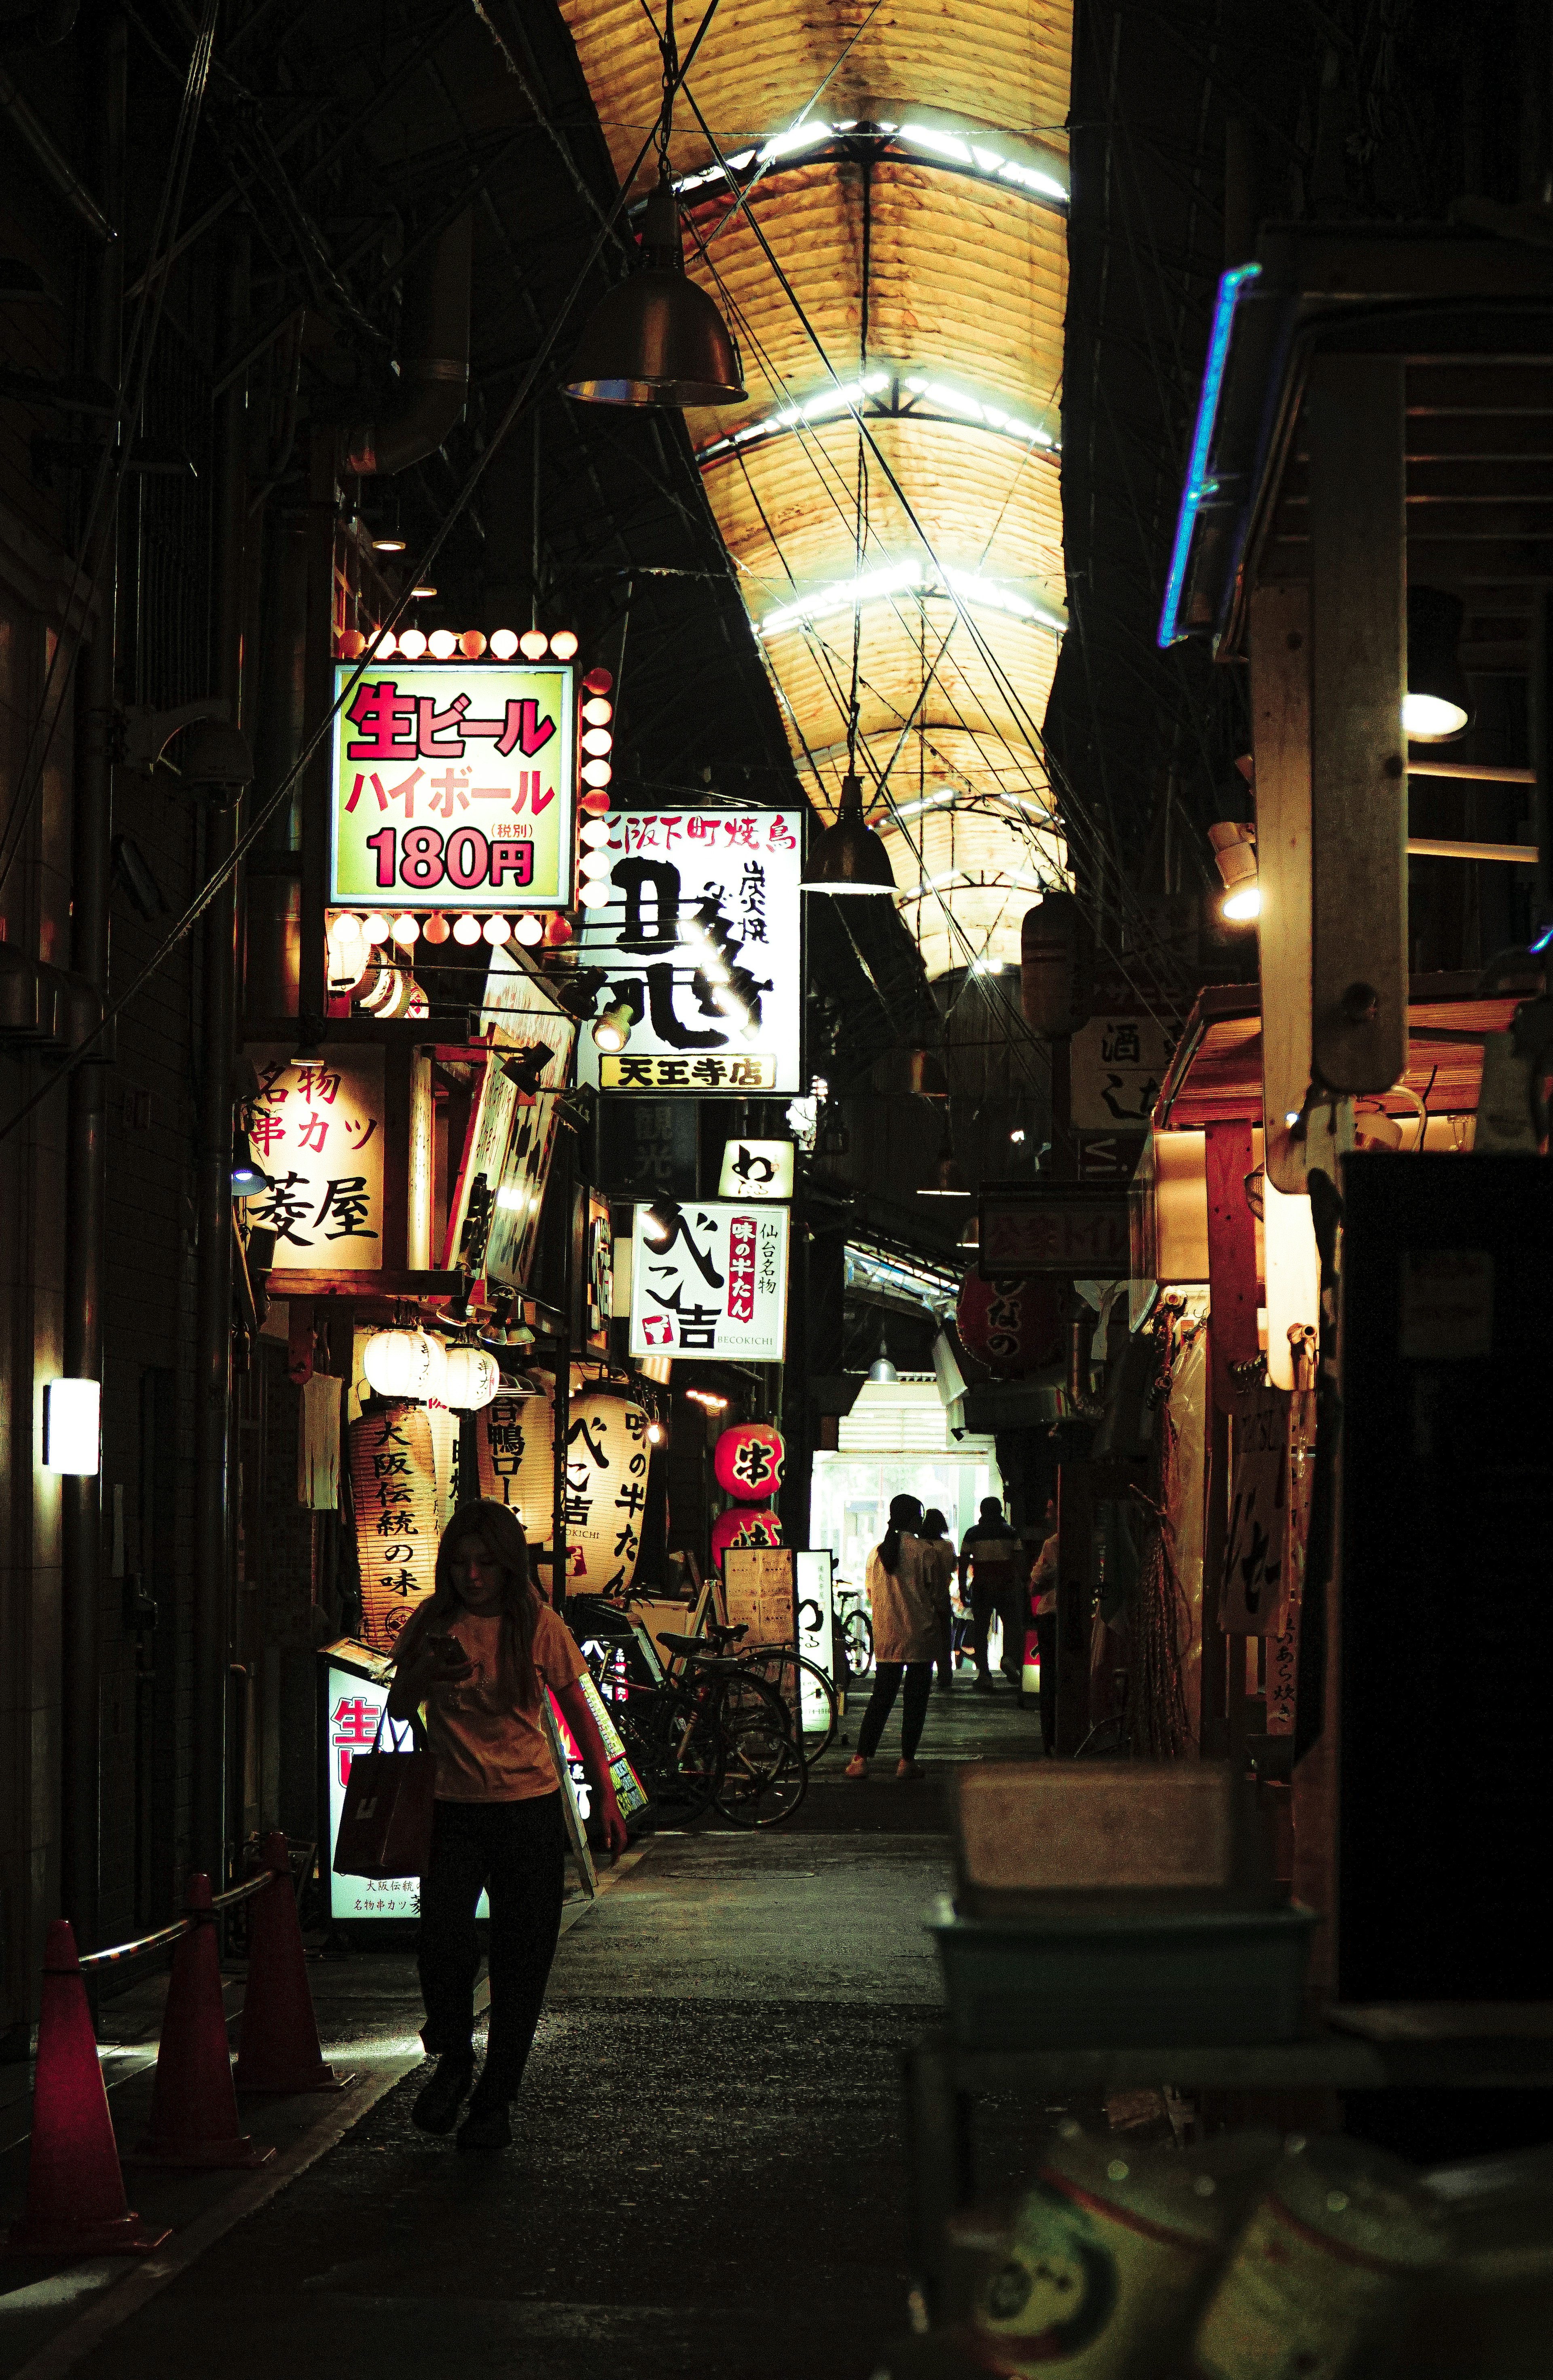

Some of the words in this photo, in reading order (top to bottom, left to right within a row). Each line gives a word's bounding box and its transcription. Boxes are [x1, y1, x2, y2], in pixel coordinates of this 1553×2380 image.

[345, 682, 557, 761] 生ビール
[345, 765, 555, 818] ハイボール
[366, 826, 534, 888] 180円
[608, 814, 797, 853] 阪下町焼鳥
[258, 1061, 341, 1104] 名物
[618, 1058, 762, 1086] 天王寺店
[250, 1108, 378, 1158] 串カツ
[247, 1171, 379, 1246] 菱屋
[729, 1222, 757, 1317] 味の牛たん
[757, 1223, 779, 1294] 仙台名物
[717, 1335, 773, 1346] BECOKICHI
[737, 1442, 772, 1486] 串
[374, 1421, 421, 1597] 大阪伝統の味
[566, 1529, 599, 1539] OKICHI
